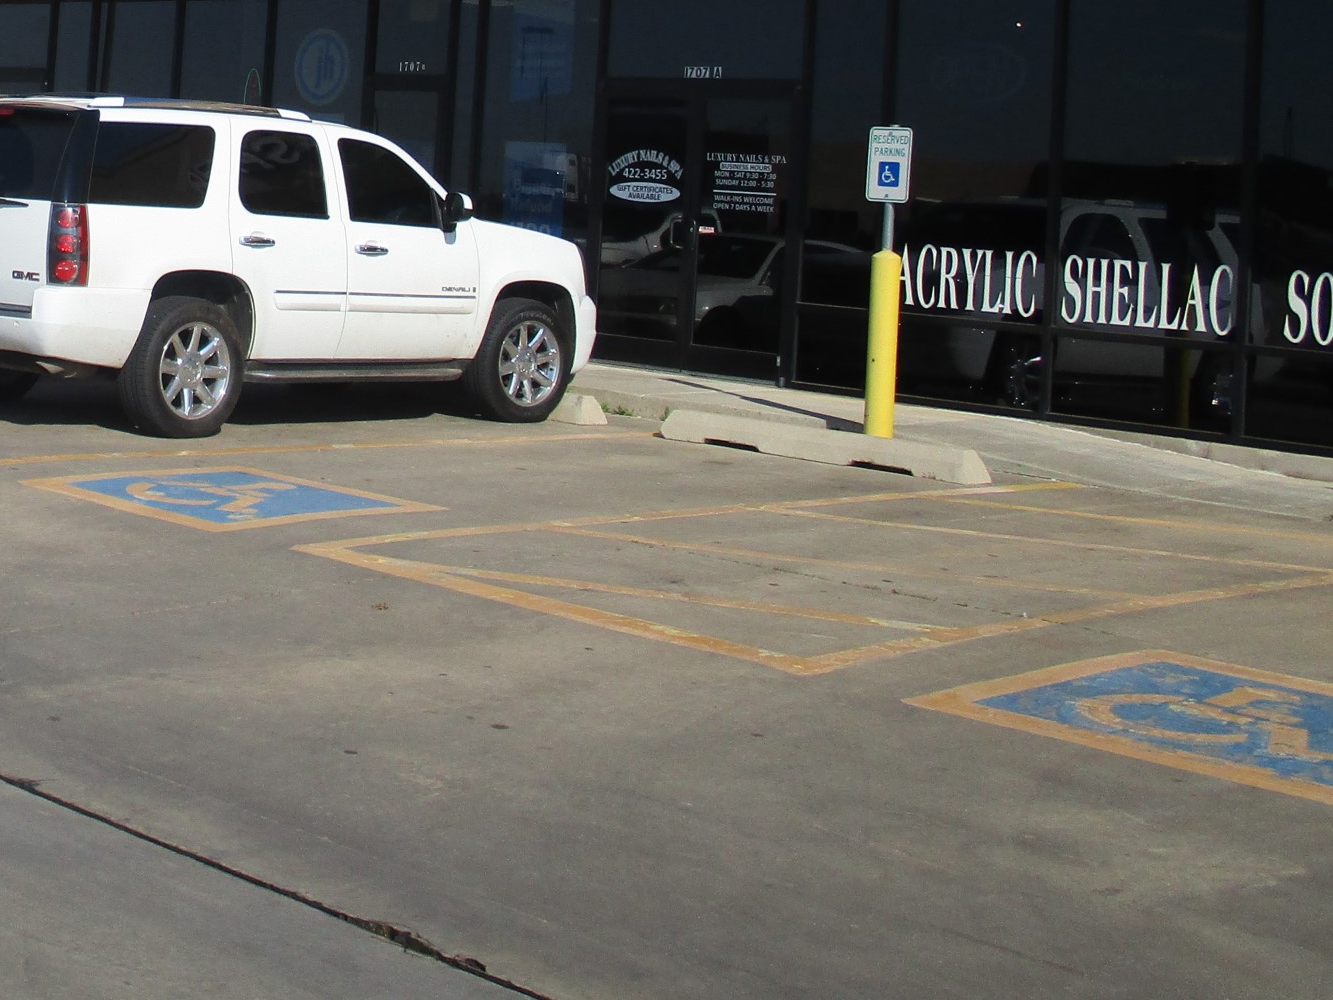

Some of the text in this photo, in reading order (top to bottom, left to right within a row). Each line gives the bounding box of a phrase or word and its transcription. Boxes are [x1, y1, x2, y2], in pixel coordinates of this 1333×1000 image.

[684, 66, 722, 79] 1707 A
[873, 134, 909, 144] RESERVED
[874, 147, 905, 157] PARKING
[707, 152, 738, 162] LUXURY
[739, 154, 763, 163] NAILS
[770, 155, 787, 164] SPA
[608, 150, 639, 176] LUXURY
[639, 149, 664, 164] NAILS
[668, 159, 683, 180] SPA
[721, 163, 771, 172] BUSINESS HOURS
[623, 168, 668, 180] 422-3455
[714, 170, 730, 178] MON
[734, 171, 745, 179] SAT
[617, 184, 673, 195] GIFT CERTIFICATES
[628, 192, 662, 201] AVAILABLE
[713, 195, 774, 205] WALK-INS WELCOME
[713, 202, 729, 210] OPEN
[735, 204, 750, 212] DAYS
[757, 205, 775, 213] WEEK
[12, 270, 40, 281] GMC
[899, 243, 1333, 347] ACRYLIC SHELLAC SO
